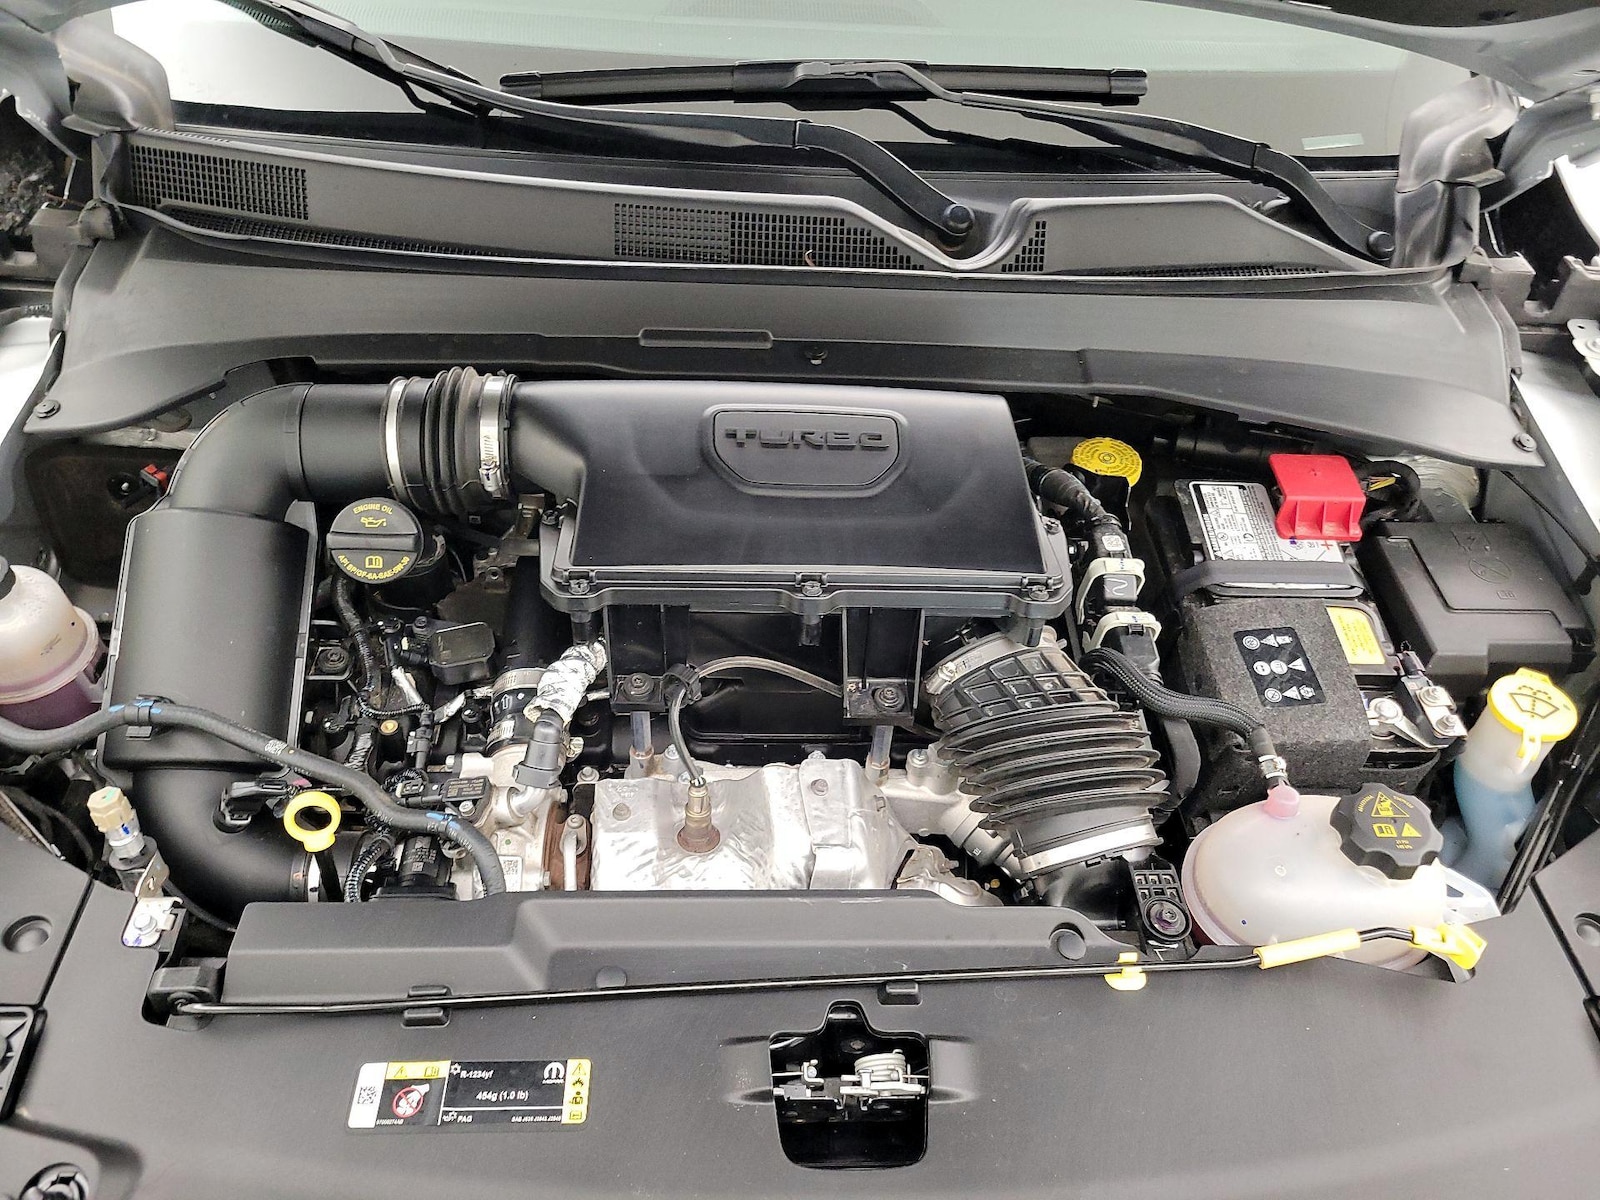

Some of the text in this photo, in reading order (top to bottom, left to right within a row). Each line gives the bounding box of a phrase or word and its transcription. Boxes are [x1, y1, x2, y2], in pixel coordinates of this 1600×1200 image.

[725, 429, 890, 451] TURBO
[353, 503, 393, 515] ENGINE OIL
[337, 555, 348, 567] API
[460, 1069, 494, 1080] R-1234yf
[475, 1090, 529, 1102] 454g (1.0 lb)
